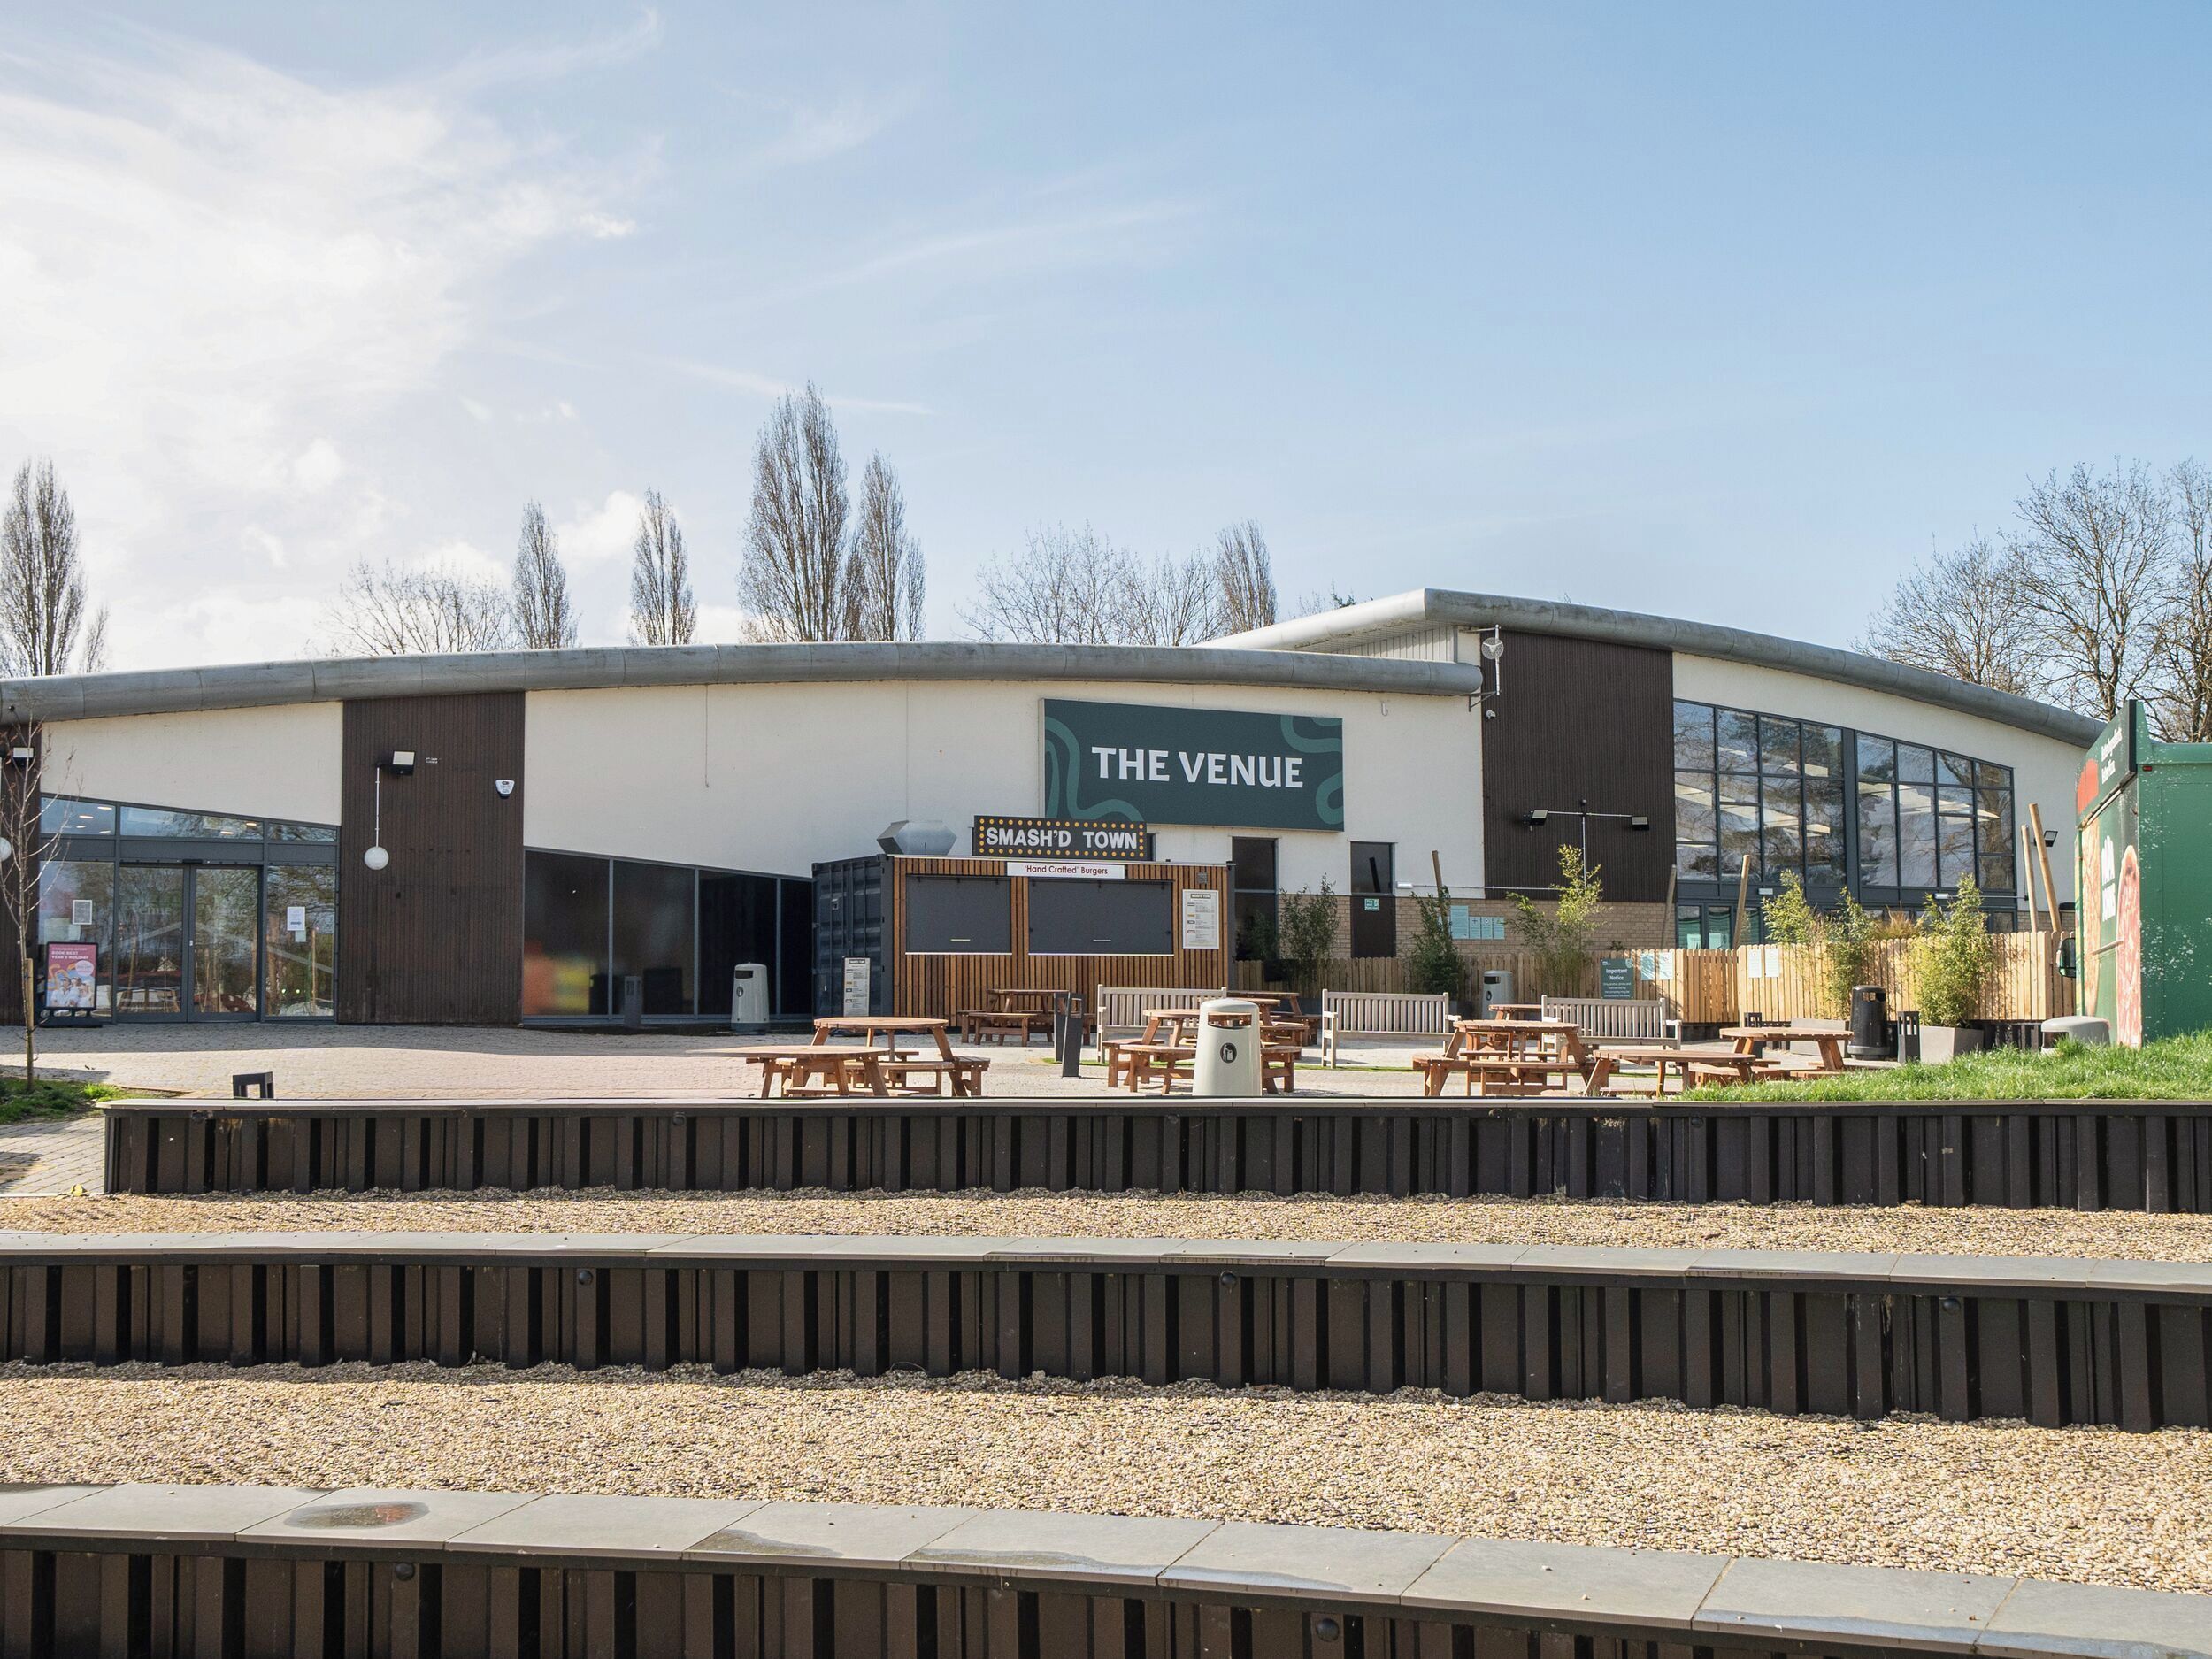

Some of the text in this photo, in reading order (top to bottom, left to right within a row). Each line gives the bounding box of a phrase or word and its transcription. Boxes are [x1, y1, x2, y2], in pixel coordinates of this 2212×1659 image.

[1091, 746, 1303, 788] THE VENUE
[986, 826, 1137, 849] SMASH'D TOWN
[1080, 866, 1109, 876] Burgers
